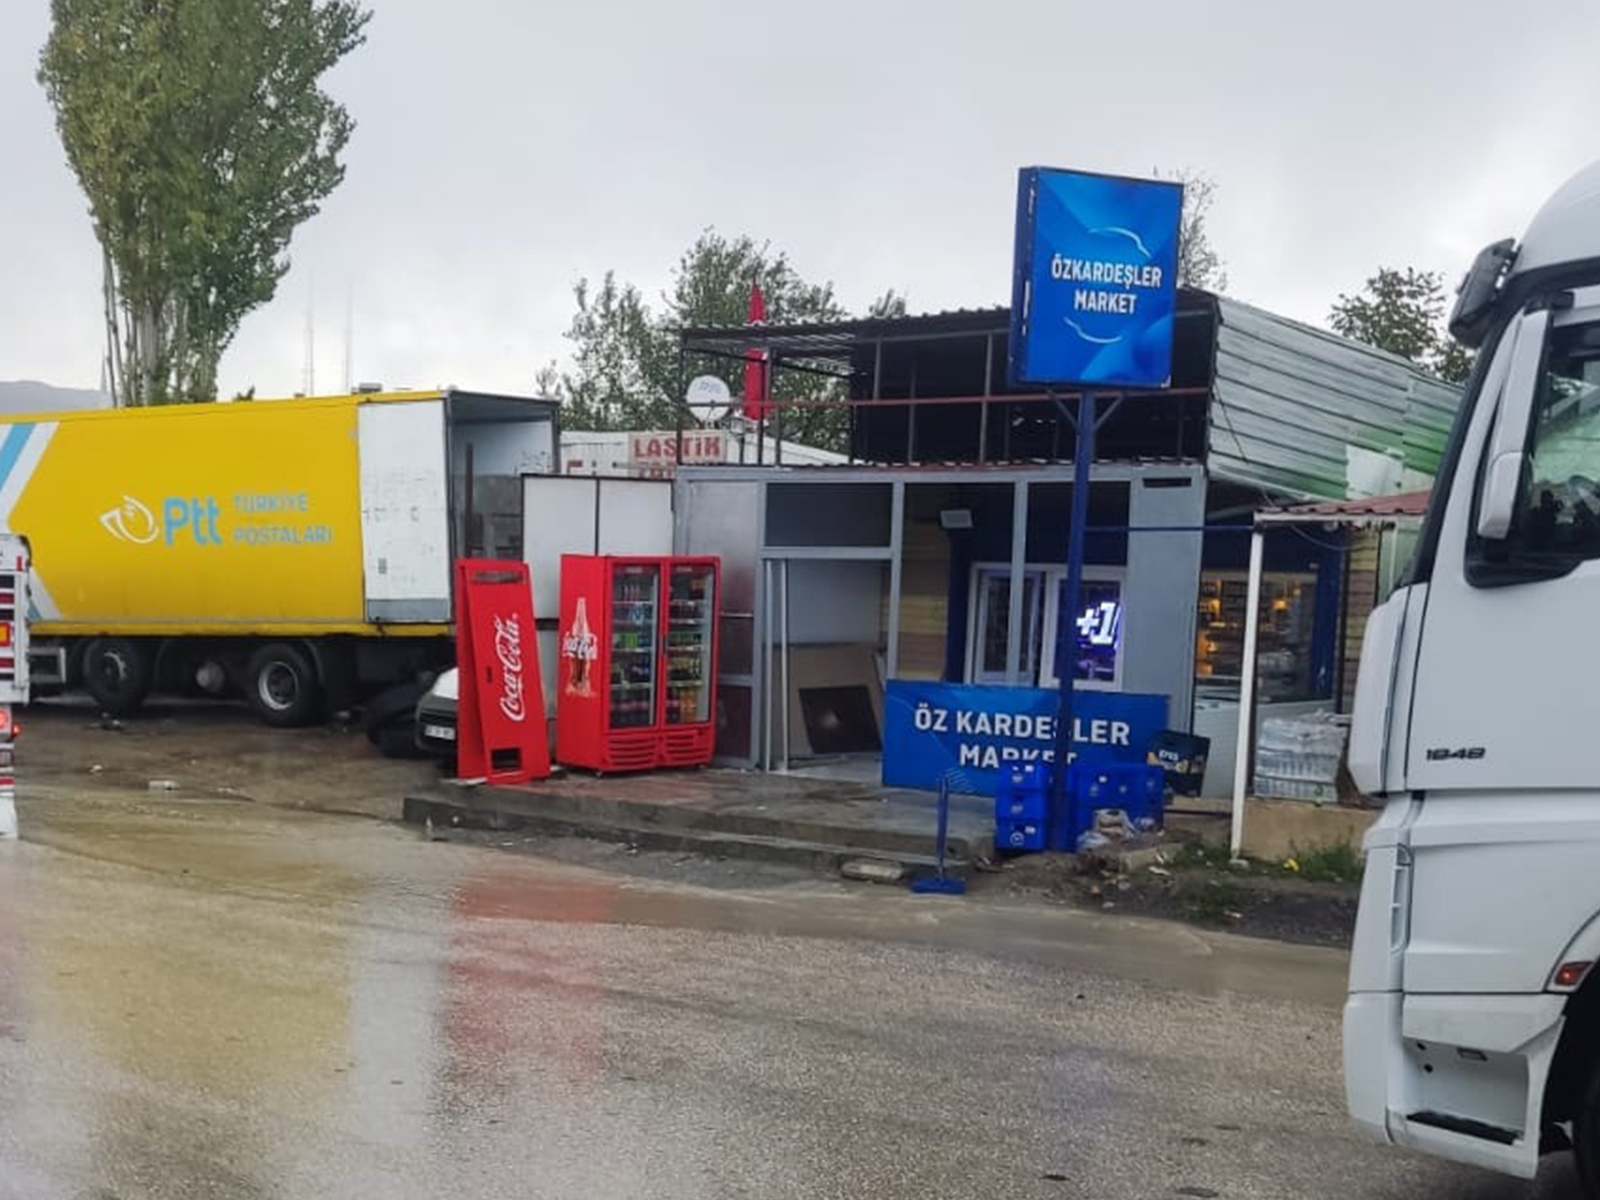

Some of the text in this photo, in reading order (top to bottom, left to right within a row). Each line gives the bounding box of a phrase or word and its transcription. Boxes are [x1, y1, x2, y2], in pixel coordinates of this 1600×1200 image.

[1052, 253, 1162, 289] ÖZKARDEŞLER
[1074, 290, 1137, 314] MARKET
[232, 491, 308, 512] TÜRKİYE
[163, 496, 222, 546] Ptt
[232, 525, 333, 543] POSTALARI
[1076, 602, 1120, 645] +1
[914, 702, 948, 732] ÖZ
